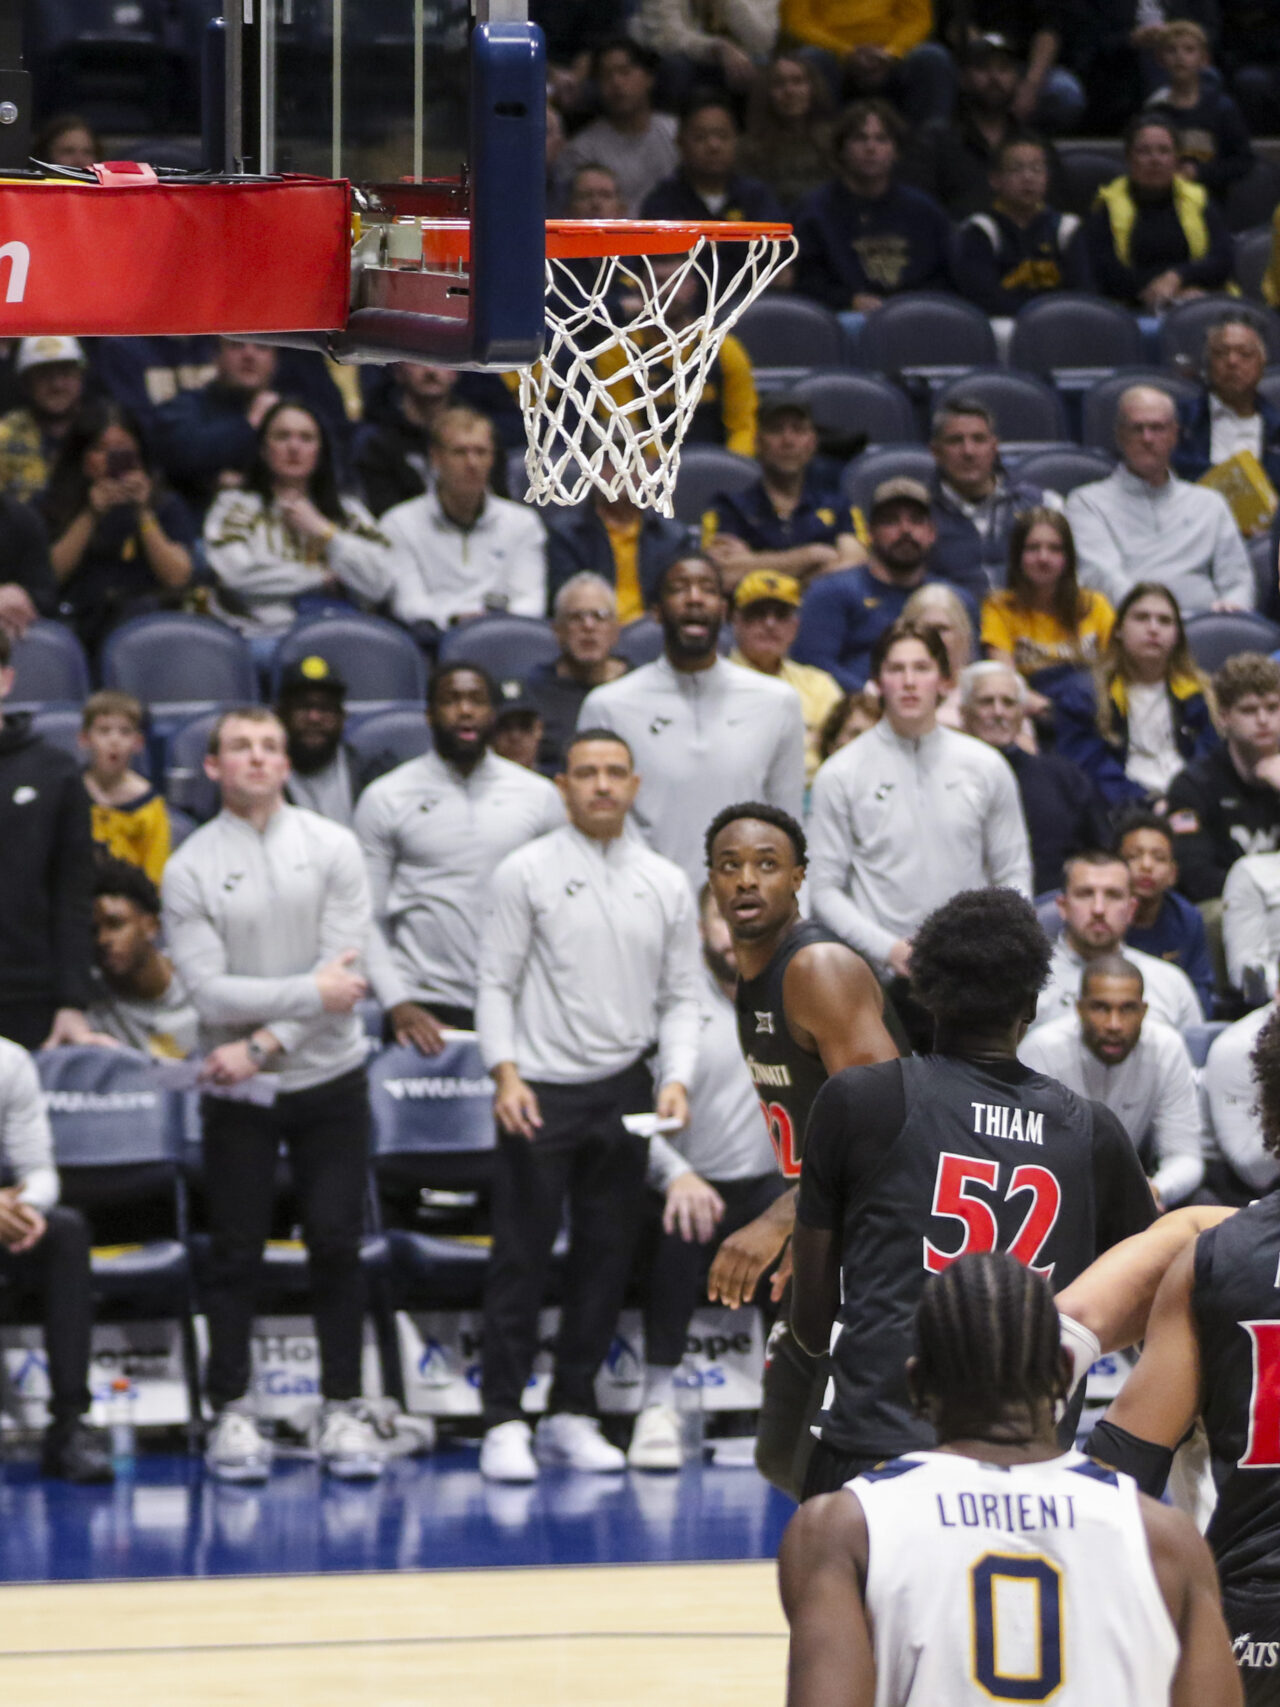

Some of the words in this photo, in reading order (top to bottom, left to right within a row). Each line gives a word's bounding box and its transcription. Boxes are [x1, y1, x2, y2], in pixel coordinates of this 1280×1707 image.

[971, 1102, 1044, 1145] THIAM
[923, 1151, 1061, 1280] 52
[686, 1333, 752, 1361] ope
[936, 1493, 1075, 1532] LORIENT
[968, 1550, 1065, 1705] 0
